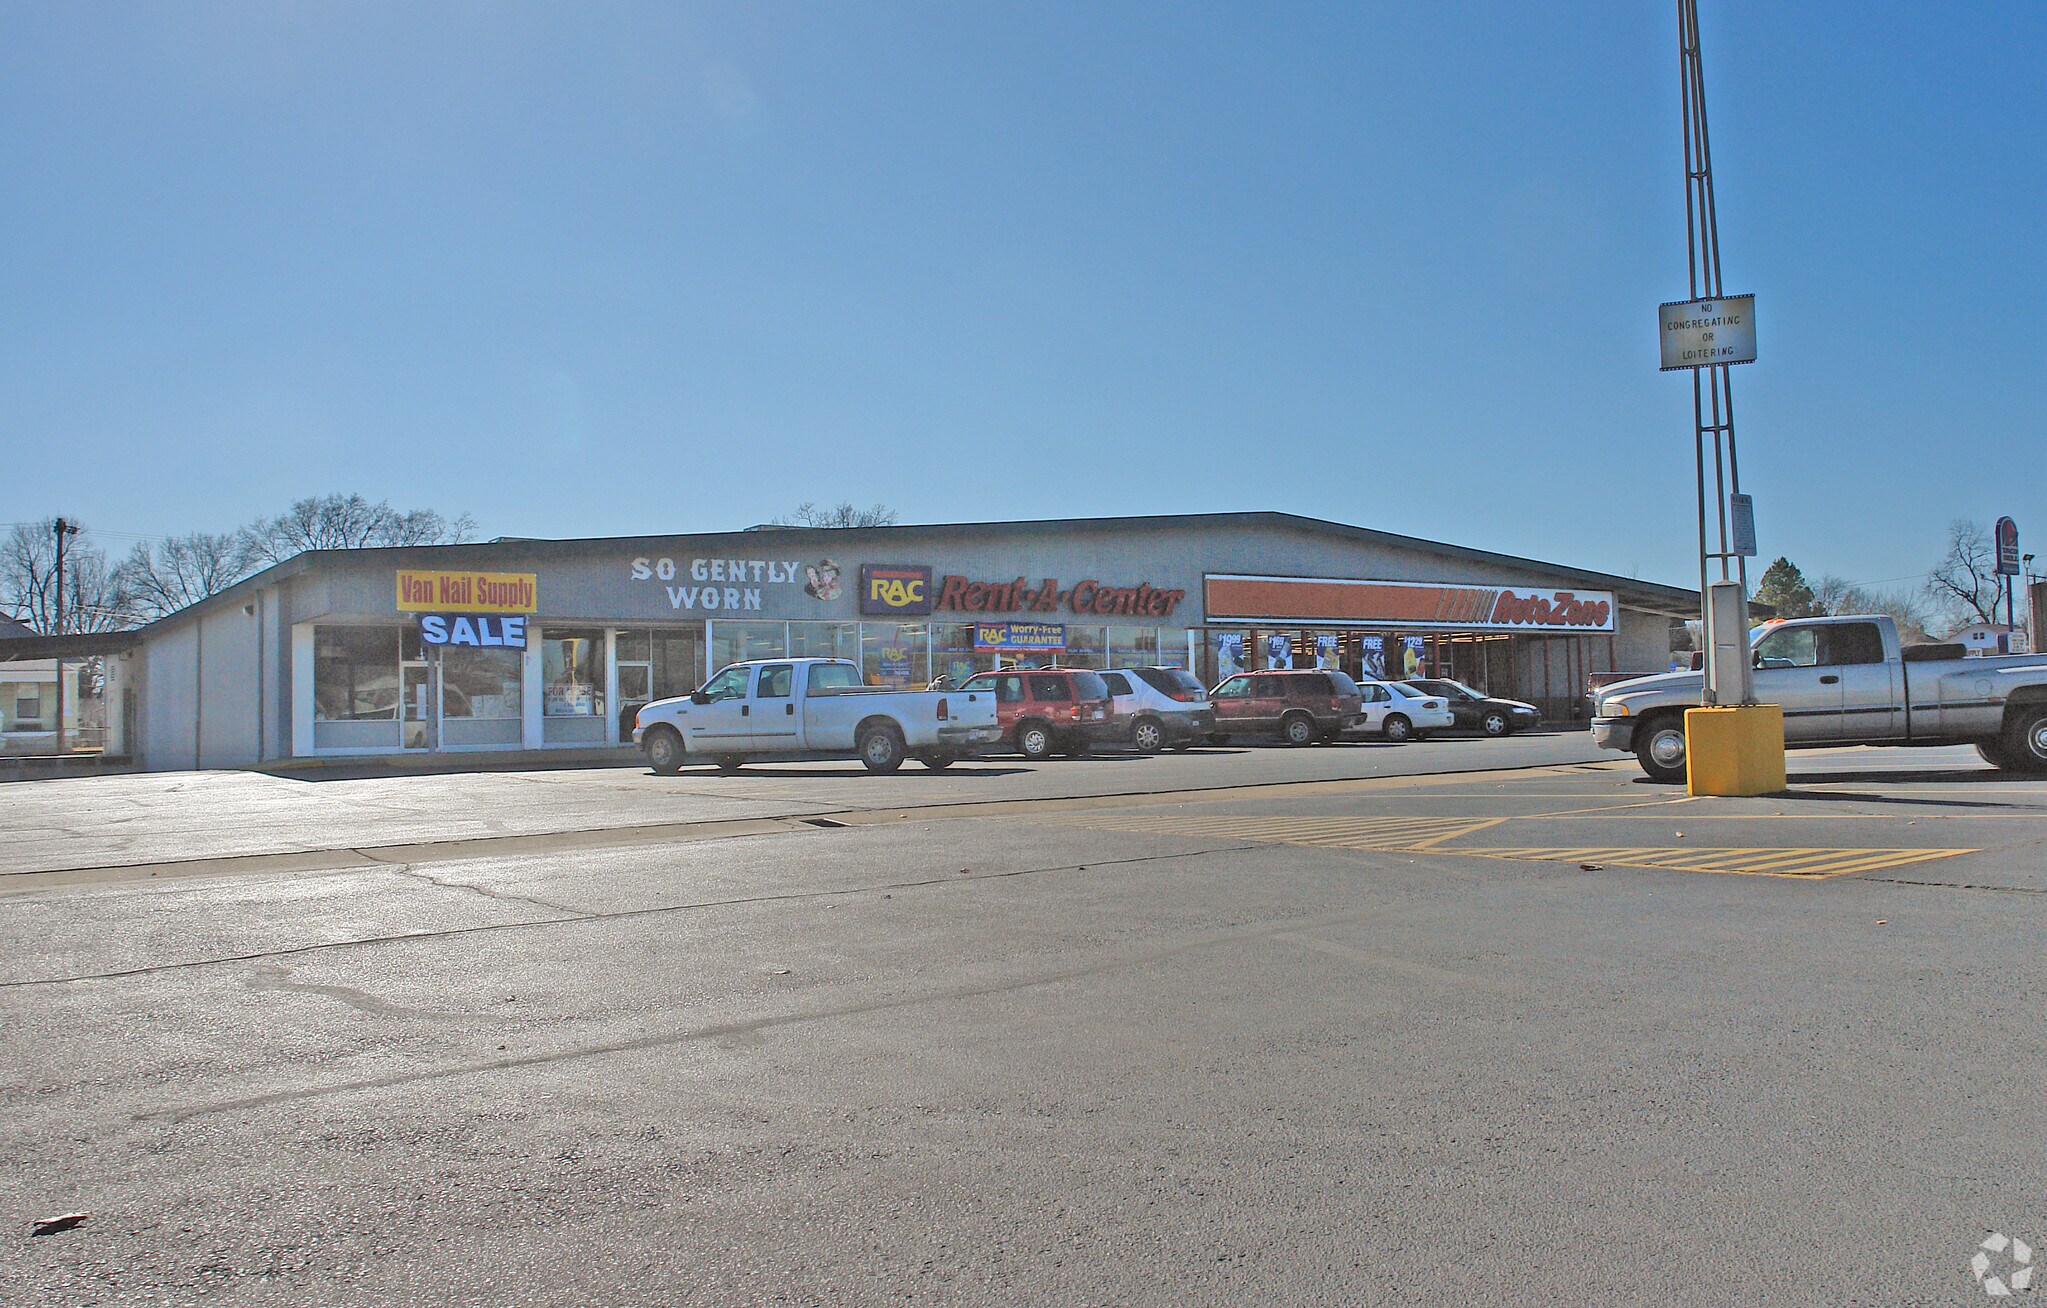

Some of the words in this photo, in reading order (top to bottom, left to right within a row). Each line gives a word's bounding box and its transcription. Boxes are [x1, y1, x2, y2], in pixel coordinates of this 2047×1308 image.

[1701, 304, 1712, 313] NO
[1667, 316, 1740, 330] CONGREGATING
[1702, 332, 1714, 342] OR
[1682, 346, 1734, 360] LOITERING
[630, 557, 677, 581] SO
[690, 558, 799, 583] GENTLY
[401, 575, 434, 603] Van
[440, 576, 472, 604] Nail
[477, 576, 533, 608] Supply
[665, 586, 761, 610] WORN
[871, 579, 924, 607] RAC
[1491, 590, 1609, 626] AutoZone
[421, 615, 526, 647] SALE
[979, 629, 1007, 645] RAC
[1011, 635, 1062, 644] GUARANTEE
[1317, 636, 1338, 647] FREE
[1363, 638, 1383, 650] FREE
[881, 647, 908, 662] RAC
